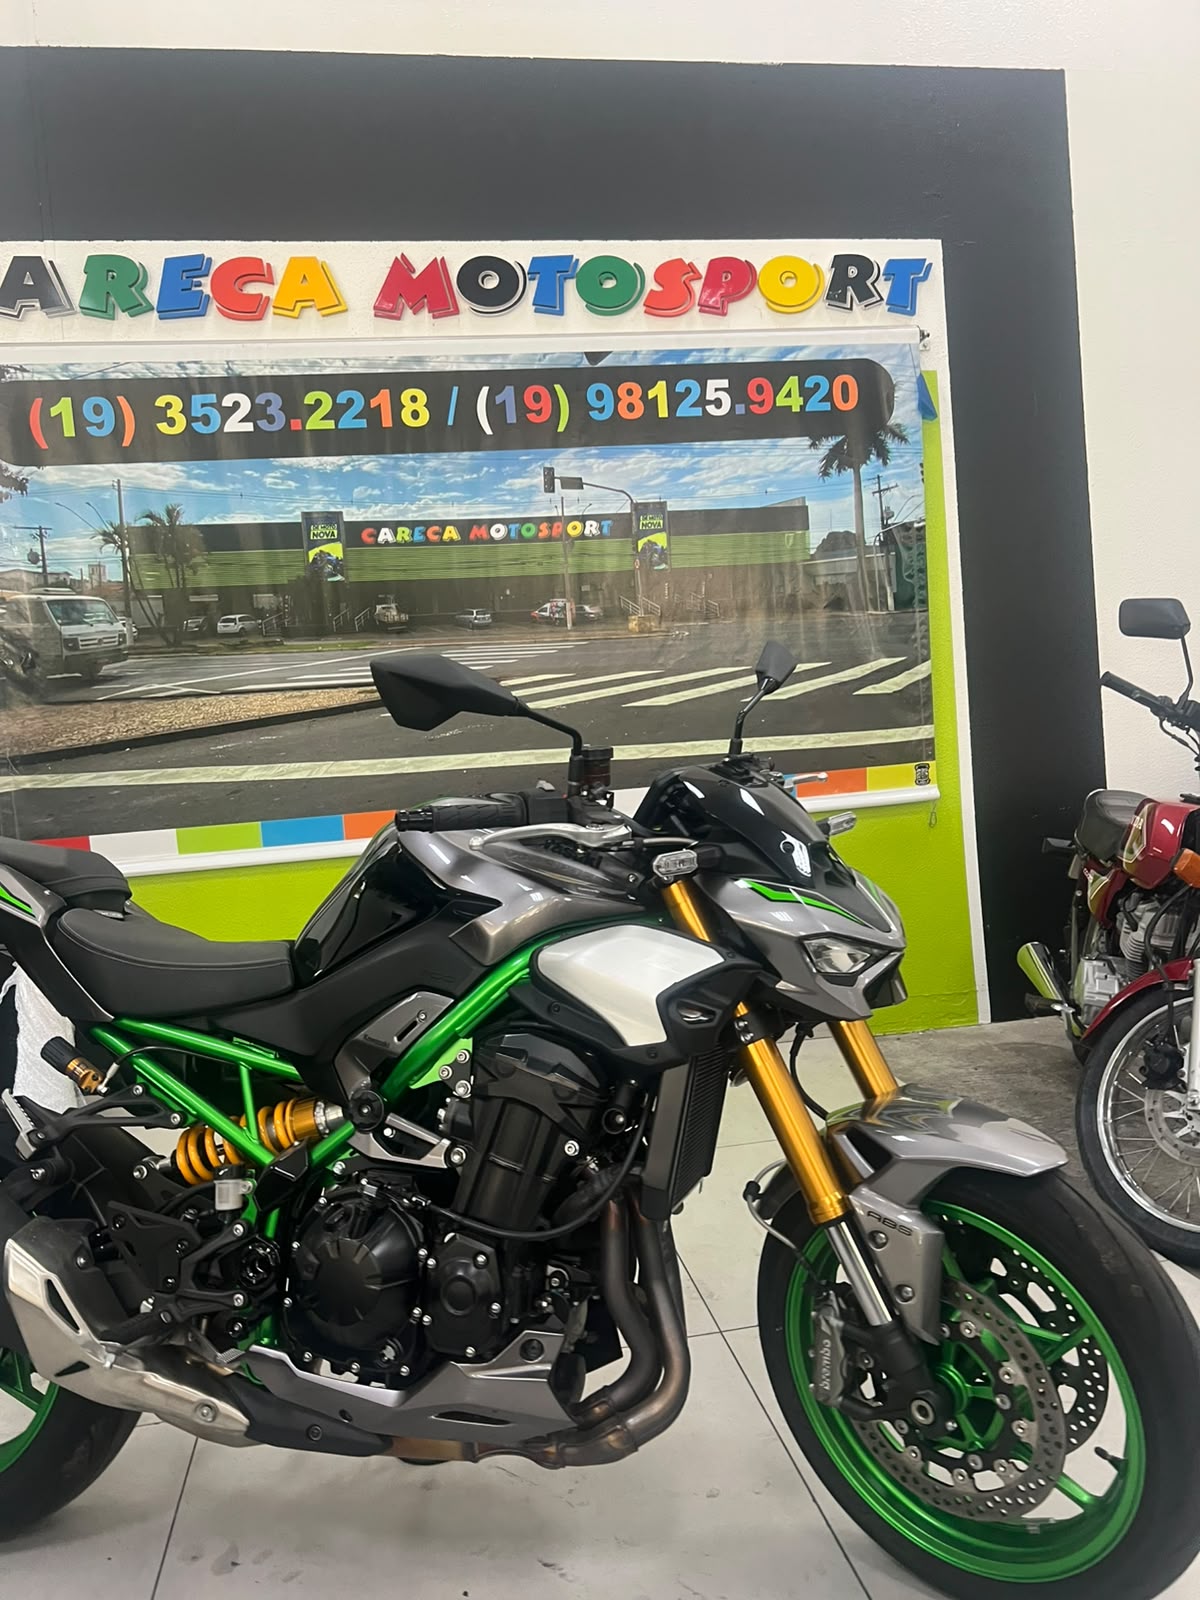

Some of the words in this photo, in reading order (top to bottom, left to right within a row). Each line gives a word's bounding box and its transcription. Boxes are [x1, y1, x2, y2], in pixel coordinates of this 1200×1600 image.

[374, 252, 932, 320] MOTOSPORT
[29, 395, 136, 450] (19)
[154, 386, 430, 436] 3523.2218
[476, 384, 570, 436] (19)
[586, 374, 860, 422] 98125.9420
[312, 530, 336, 539] NOVA
[360, 525, 462, 545] CARECA
[469, 520, 613, 541] MOTOSPORT
[641, 521, 662, 529] NOVA
[867, 1210, 913, 1237] ABS
[819, 1339, 832, 1391] brembo
